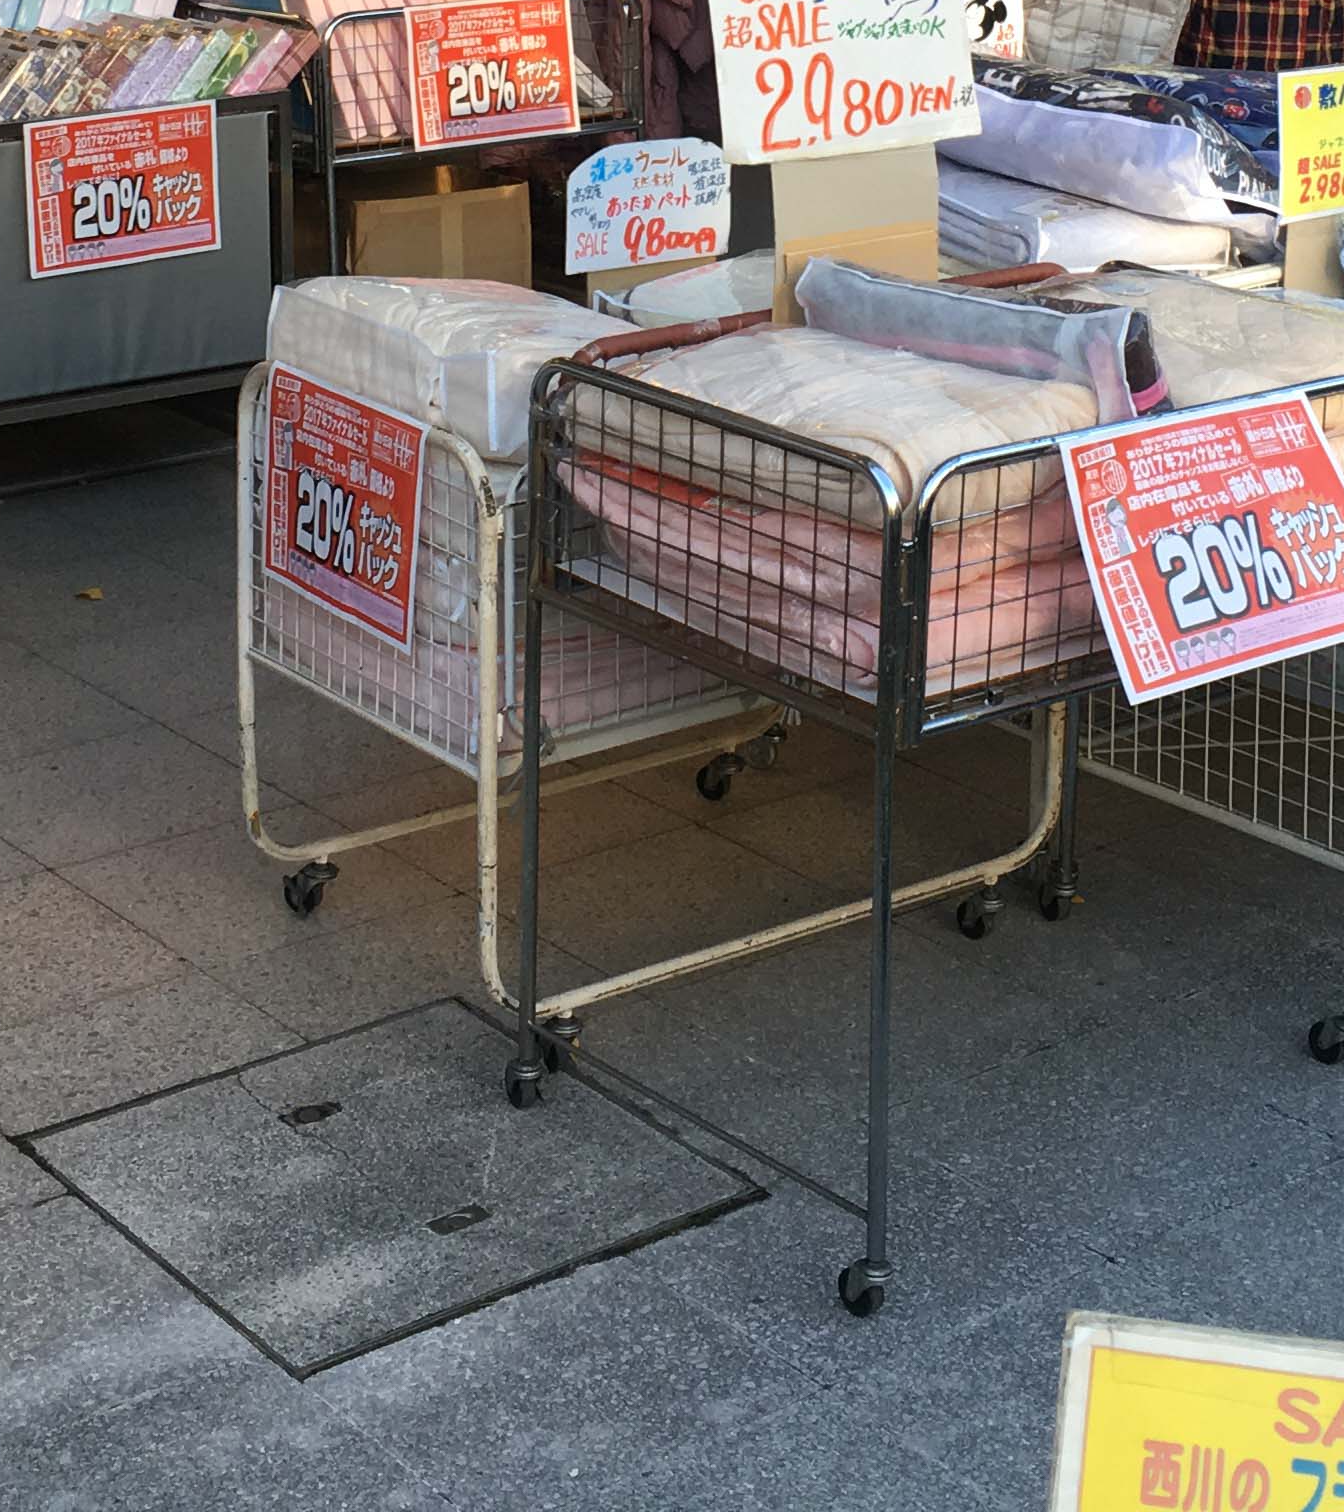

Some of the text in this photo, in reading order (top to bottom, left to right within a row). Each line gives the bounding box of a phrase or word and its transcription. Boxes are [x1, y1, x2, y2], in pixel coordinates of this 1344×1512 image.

[754, 1, 833, 51] SALE
[448, 60, 516, 116] 20%
[516, 57, 561, 78] キャッシュ
[520, 80, 560, 104] バック
[910, 75, 956, 116] YEN
[1312, 153, 1342, 171] SALE
[153, 170, 202, 197] キャッシュ
[74, 176, 151, 238] 20%
[156, 194, 202, 223] バック
[574, 232, 608, 260] SALE
[1129, 440, 1242, 481] 2017年ファイナルセール
[296, 469, 354, 574] 20%
[359, 501, 402, 554] キャッシュ
[358, 542, 400, 590] バック
[1156, 513, 1294, 628] 20%
